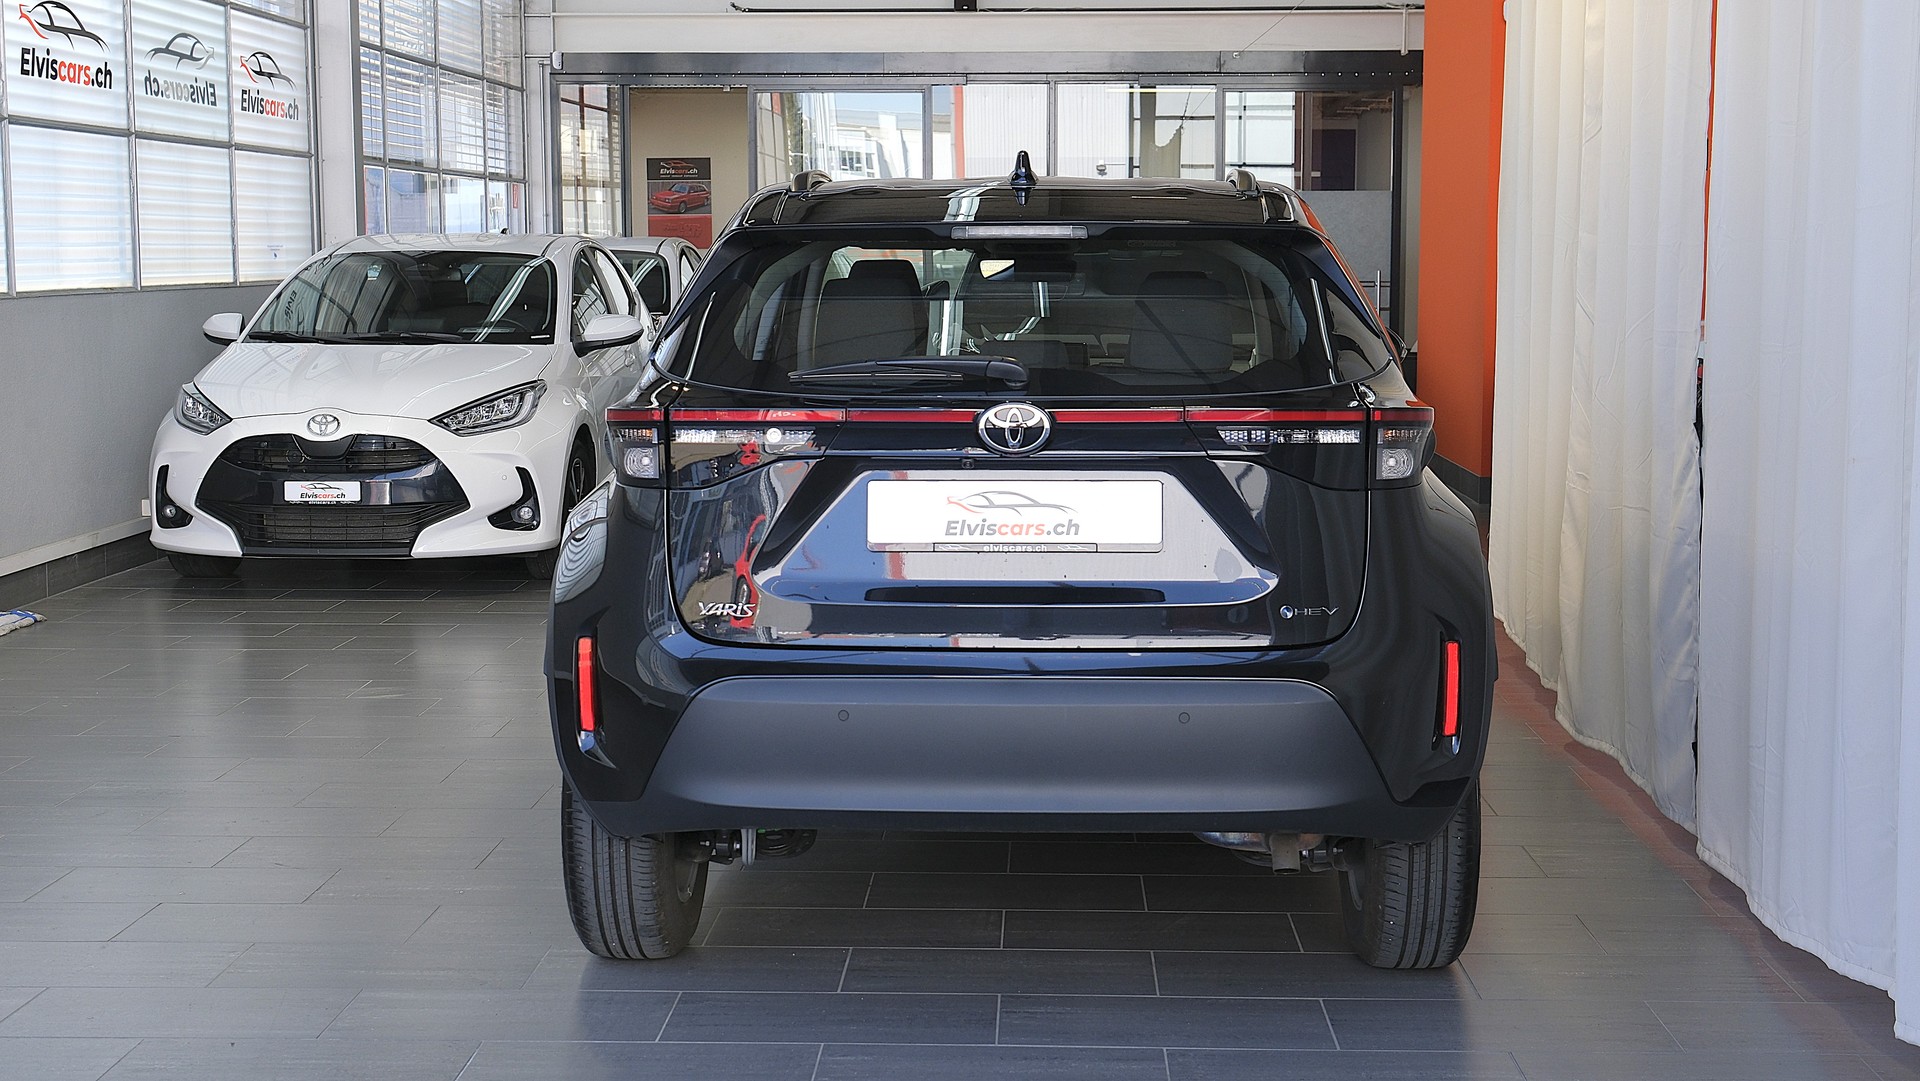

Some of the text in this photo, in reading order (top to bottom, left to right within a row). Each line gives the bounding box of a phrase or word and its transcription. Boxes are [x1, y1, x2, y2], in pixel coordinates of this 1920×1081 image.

[20, 47, 112, 90] Elviscars.ch
[240, 89, 299, 121] Elviscars.ch
[945, 518, 1080, 536] Elviscars.ch
[983, 543, 1048, 553] elviscars.ch
[1294, 606, 1340, 616] HEV
